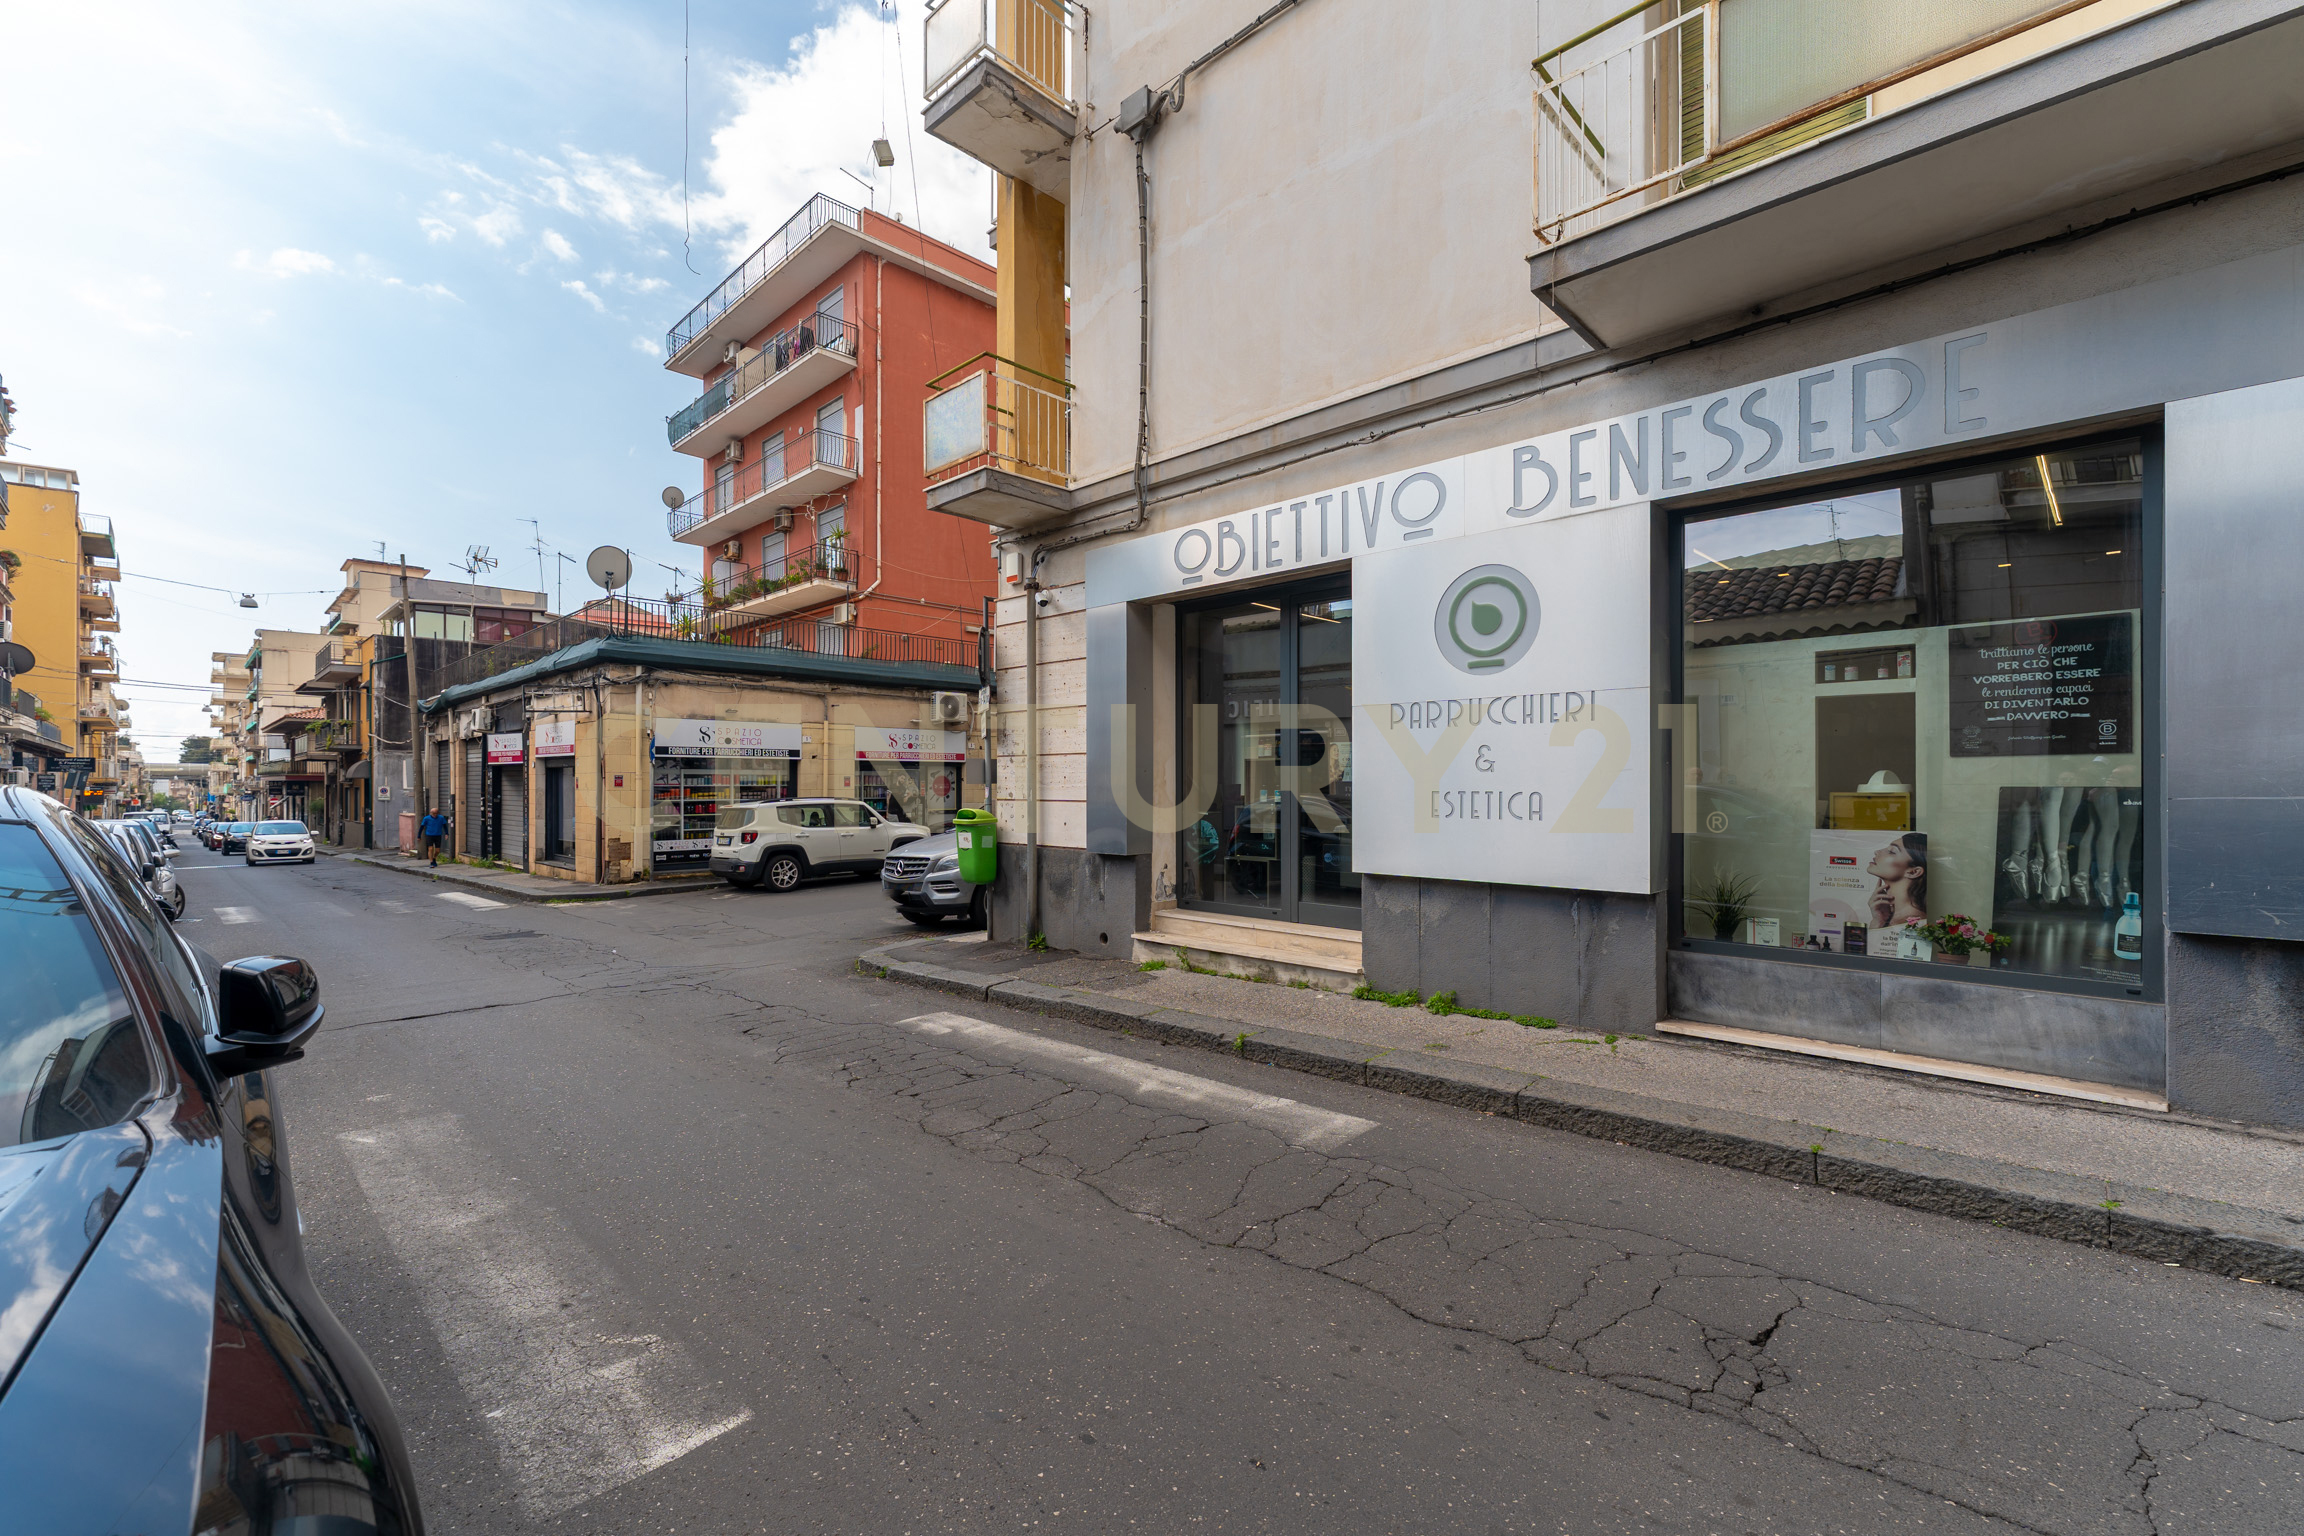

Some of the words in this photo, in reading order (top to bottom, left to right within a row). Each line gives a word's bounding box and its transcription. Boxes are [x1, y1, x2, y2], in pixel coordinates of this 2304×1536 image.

[1174, 470, 1447, 585] OBIETTIVO
[1506, 332, 1988, 518] BENESSERE
[1978, 646, 2034, 658] trattiamo
[2038, 644, 2050, 655] le
[2051, 642, 2094, 657] persone
[1998, 662, 2020, 670] PER
[2022, 656, 2049, 668] CIÒ
[2053, 656, 2078, 666] CHE
[1973, 672, 2053, 684] VORREBBERO
[2056, 668, 2102, 680] ESSERE
[1982, 687, 1994, 698] le
[1994, 685, 2053, 697] renderemo
[2056, 682, 2094, 696] capaci
[1390, 690, 1596, 730] PARRUCCHIERI
[1984, 701, 1999, 710] DI
[2003, 697, 2090, 708] DIVENTARLO
[2006, 710, 2070, 721] DAVVERO
[718, 728, 762, 736] SPAZIO
[902, 734, 936, 742] SPAZIO
[718, 736, 762, 746] COSMETICA
[668, 747, 700, 755] FORNITURE
[714, 748, 753, 756] PARRUCCHIERI
[1475, 744, 1496, 773] &
[1431, 790, 1544, 821] ESTETICA
